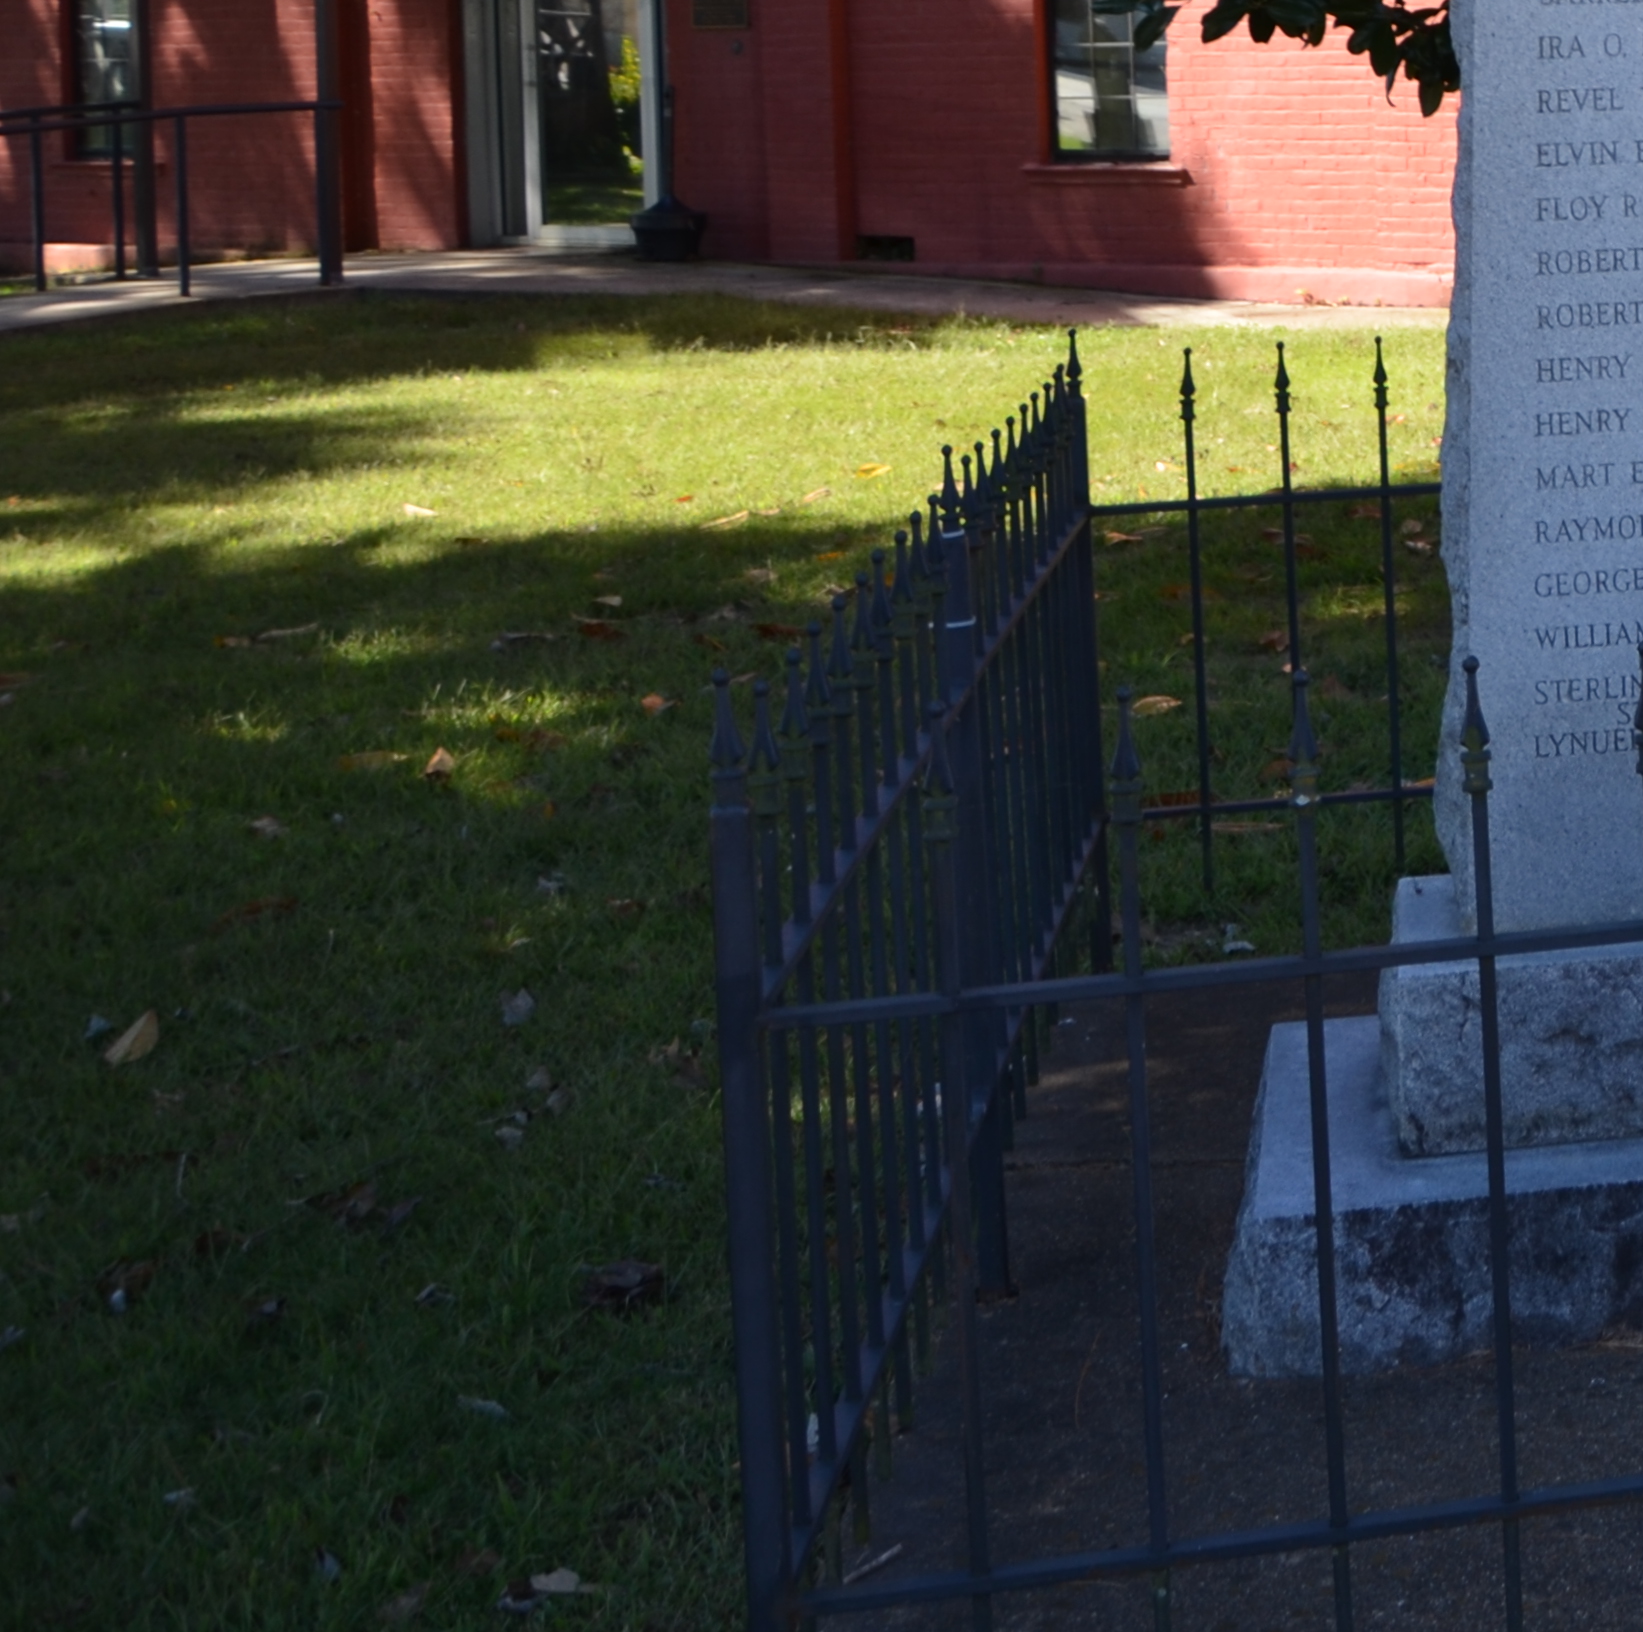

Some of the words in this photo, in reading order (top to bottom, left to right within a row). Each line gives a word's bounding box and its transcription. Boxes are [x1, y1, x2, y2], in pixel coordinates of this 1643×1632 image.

[1538, 35, 1583, 59] IRA
[1603, 34, 1628, 56] O.
[1537, 88, 1624, 113] REVEL
[1536, 141, 1620, 167] ELVIN
[1535, 196, 1608, 222] FLOY
[1536, 248, 1643, 276] ROBERT
[1536, 355, 1632, 383] HENRY
[1535, 409, 1631, 437] HENRY
[1535, 462, 1614, 489] MART
